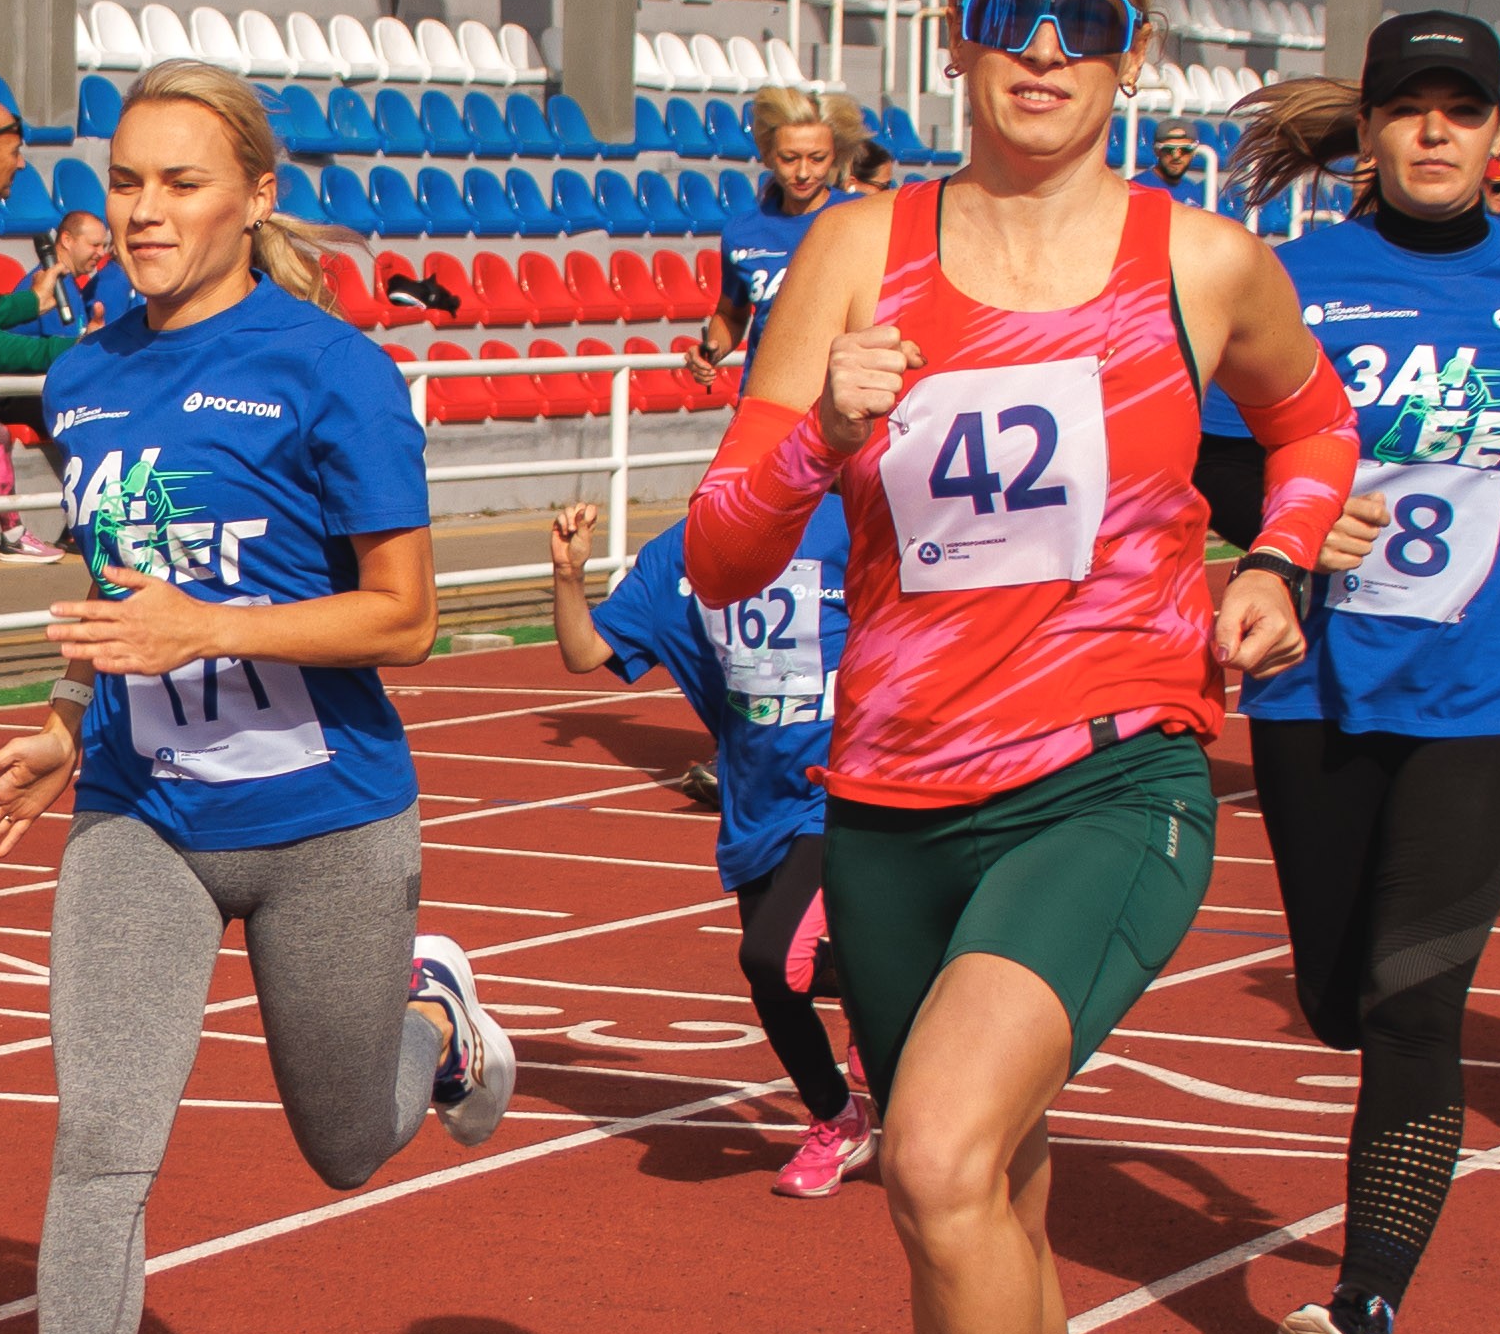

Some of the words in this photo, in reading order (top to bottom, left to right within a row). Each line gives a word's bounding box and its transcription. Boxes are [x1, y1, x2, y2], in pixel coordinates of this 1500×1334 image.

[203, 396, 281, 418] РОСАТОМ
[1344, 344, 1477, 407] ЗА!
[63, 448, 161, 529] ЗА!
[928, 405, 1067, 515] 42
[117, 519, 268, 586] БЕГ
[1385, 494, 1454, 577] 8
[723, 588, 797, 650] 162
